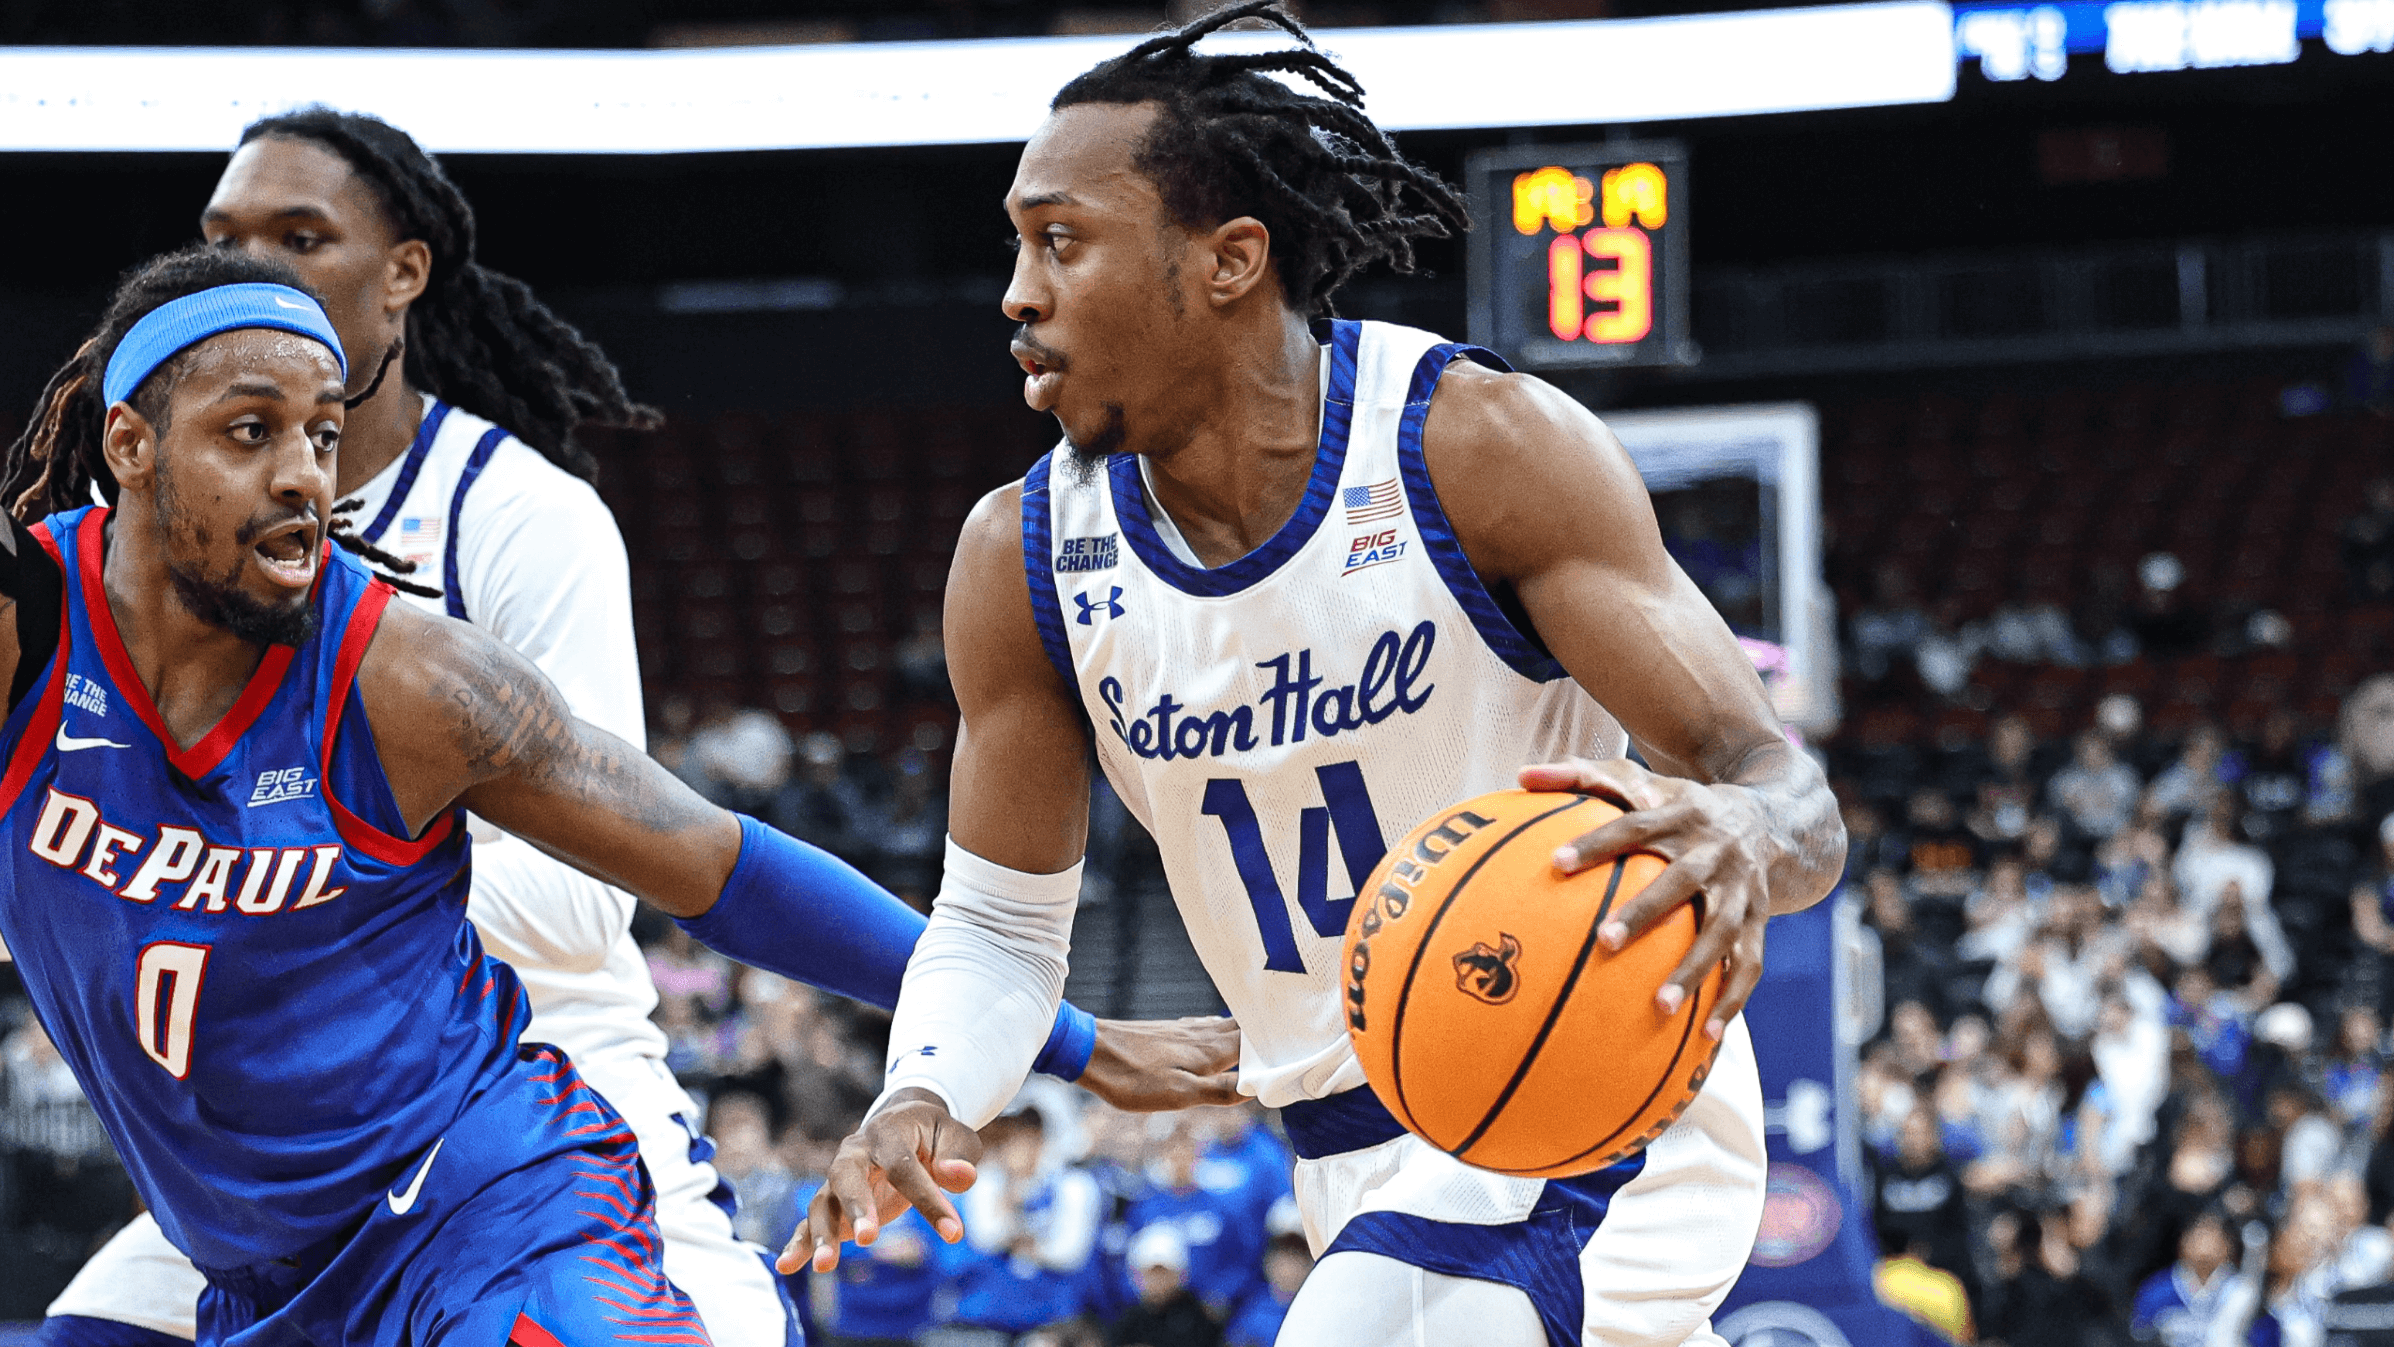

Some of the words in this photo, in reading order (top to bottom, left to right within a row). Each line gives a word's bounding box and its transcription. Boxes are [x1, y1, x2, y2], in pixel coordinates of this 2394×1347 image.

[1549, 226, 1653, 344] 13
[1063, 537, 1087, 554] BE
[1092, 532, 1118, 553] THE
[1350, 528, 1397, 552] BIG
[1055, 548, 1119, 572] CHANGE
[1345, 540, 1408, 568] EAST
[83, 678, 107, 703] THE
[1099, 676, 1258, 760] Seton
[1256, 620, 1436, 746] Hall
[250, 778, 318, 800] EAST
[257, 767, 305, 787] BIG
[1201, 760, 1390, 975] 14
[135, 940, 213, 1081] 0
